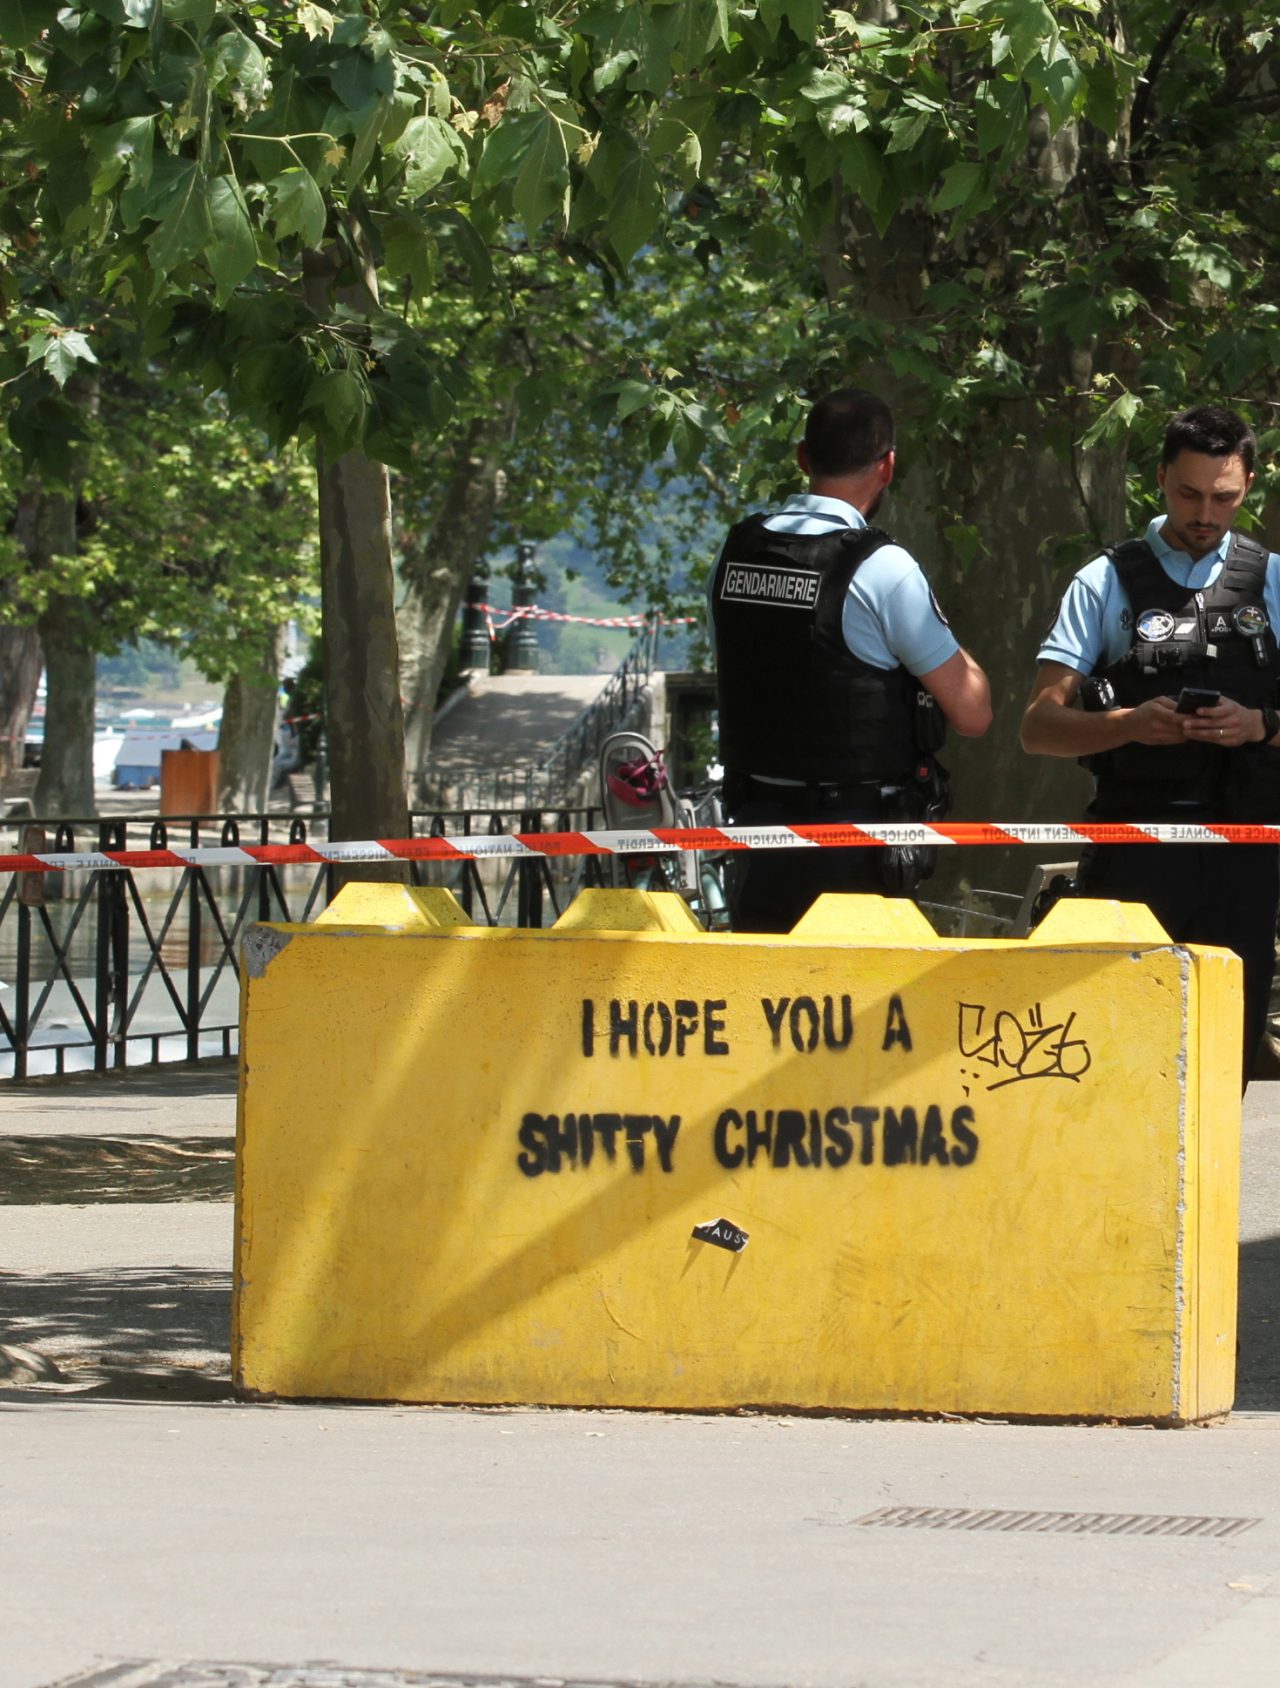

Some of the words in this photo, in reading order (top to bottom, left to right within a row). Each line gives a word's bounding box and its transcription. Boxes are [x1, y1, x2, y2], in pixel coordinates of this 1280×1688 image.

[726, 570, 818, 601] GENDARMERIE
[1216, 616, 1226, 627] A
[582, 998, 594, 1057] I
[609, 998, 730, 1058] HOPE
[760, 995, 854, 1055] YOU
[881, 994, 914, 1053] A
[517, 1112, 683, 1177] SHITTY
[713, 1104, 980, 1170] CHRISTMAS
